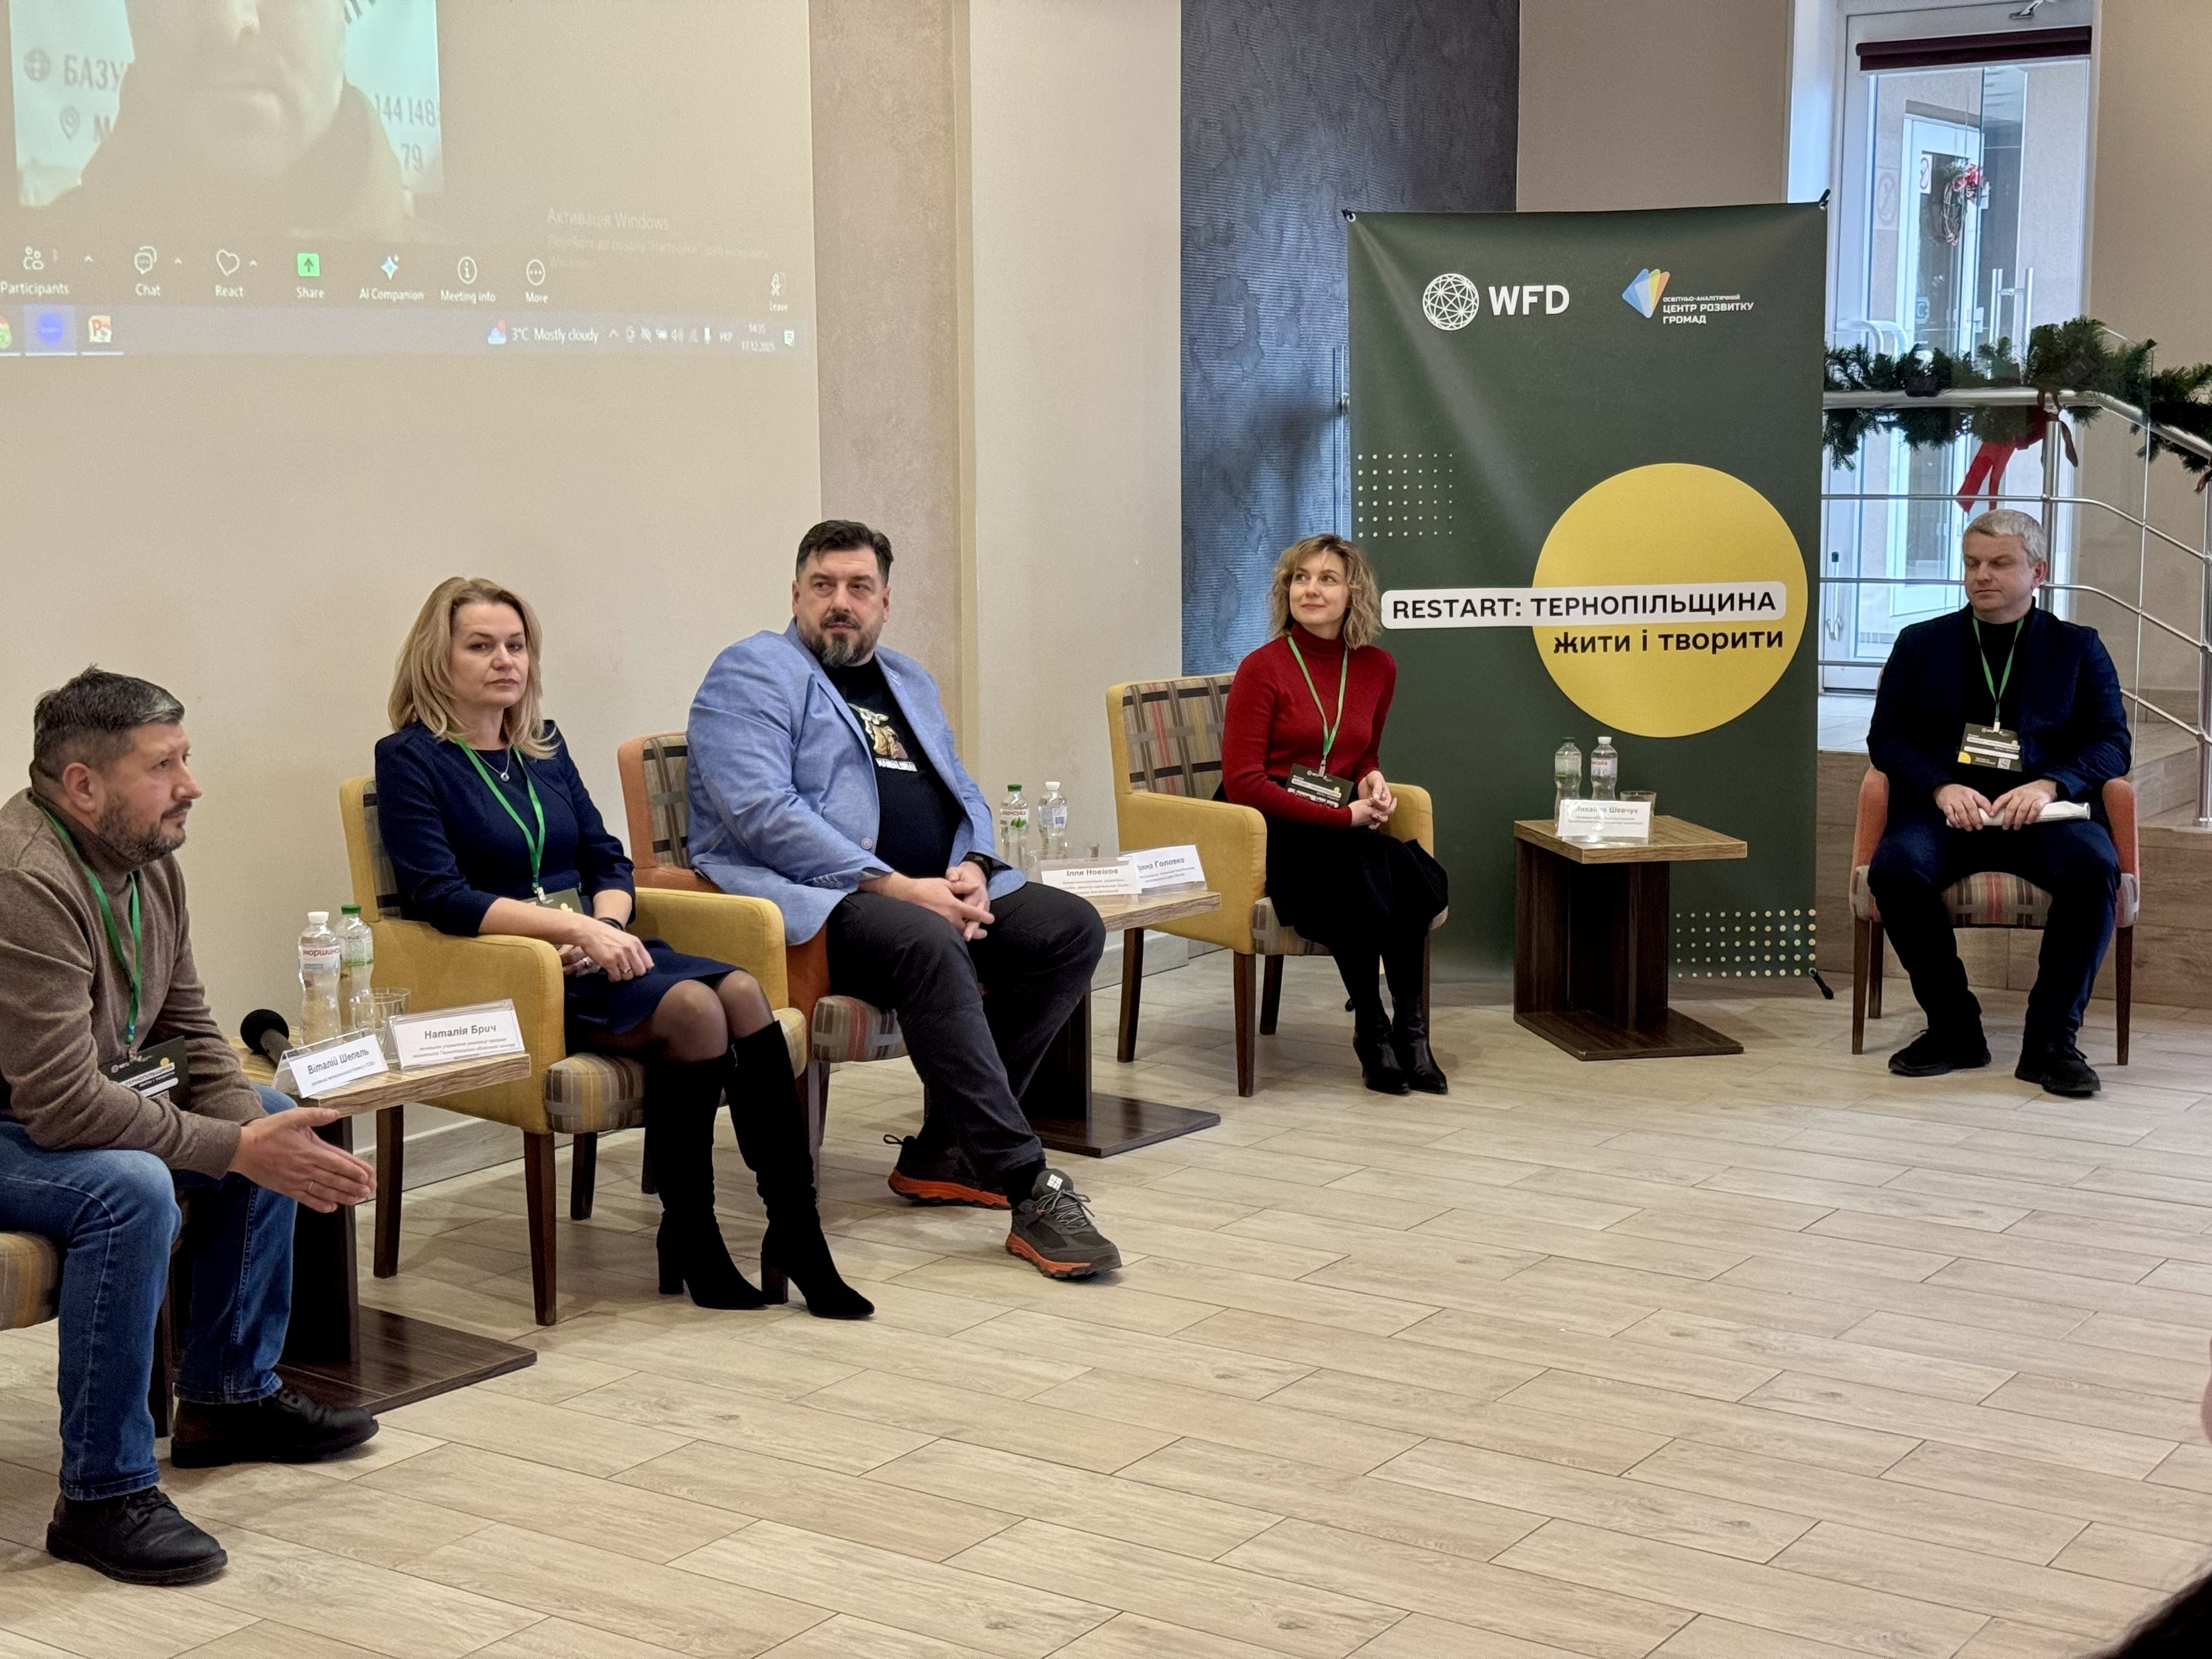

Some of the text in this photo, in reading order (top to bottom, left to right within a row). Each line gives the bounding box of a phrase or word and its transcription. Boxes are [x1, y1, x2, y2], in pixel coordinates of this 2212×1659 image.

[614, 210, 669, 230] Windows
[0, 280, 70, 296] Participants
[135, 283, 161, 297] Chat
[215, 285, 244, 297] React
[296, 286, 324, 299] Share
[360, 287, 424, 301] AI Companion
[440, 289, 496, 304] Meeting info
[526, 292, 548, 304] More
[1489, 284, 1570, 316] WFD
[769, 301, 788, 312] Leave
[1663, 302, 1754, 314] ЦЕНТР РОЗВИТКУ
[1663, 315, 1707, 325] ГРОМАД
[511, 328, 599, 343] 3°C Mostly cloudy
[1393, 592, 1777, 619] RESTART: ТЕРНОПІЛЬЩИНА
[1553, 630, 1784, 654] жити і творити
[1609, 806, 1638, 815] Шевчук
[1154, 857, 1185, 868] Головко
[424, 1025, 496, 1040] Наталія Брич
[307, 1056, 338, 1075] Віталій
[338, 1048, 370, 1064] Шепель
